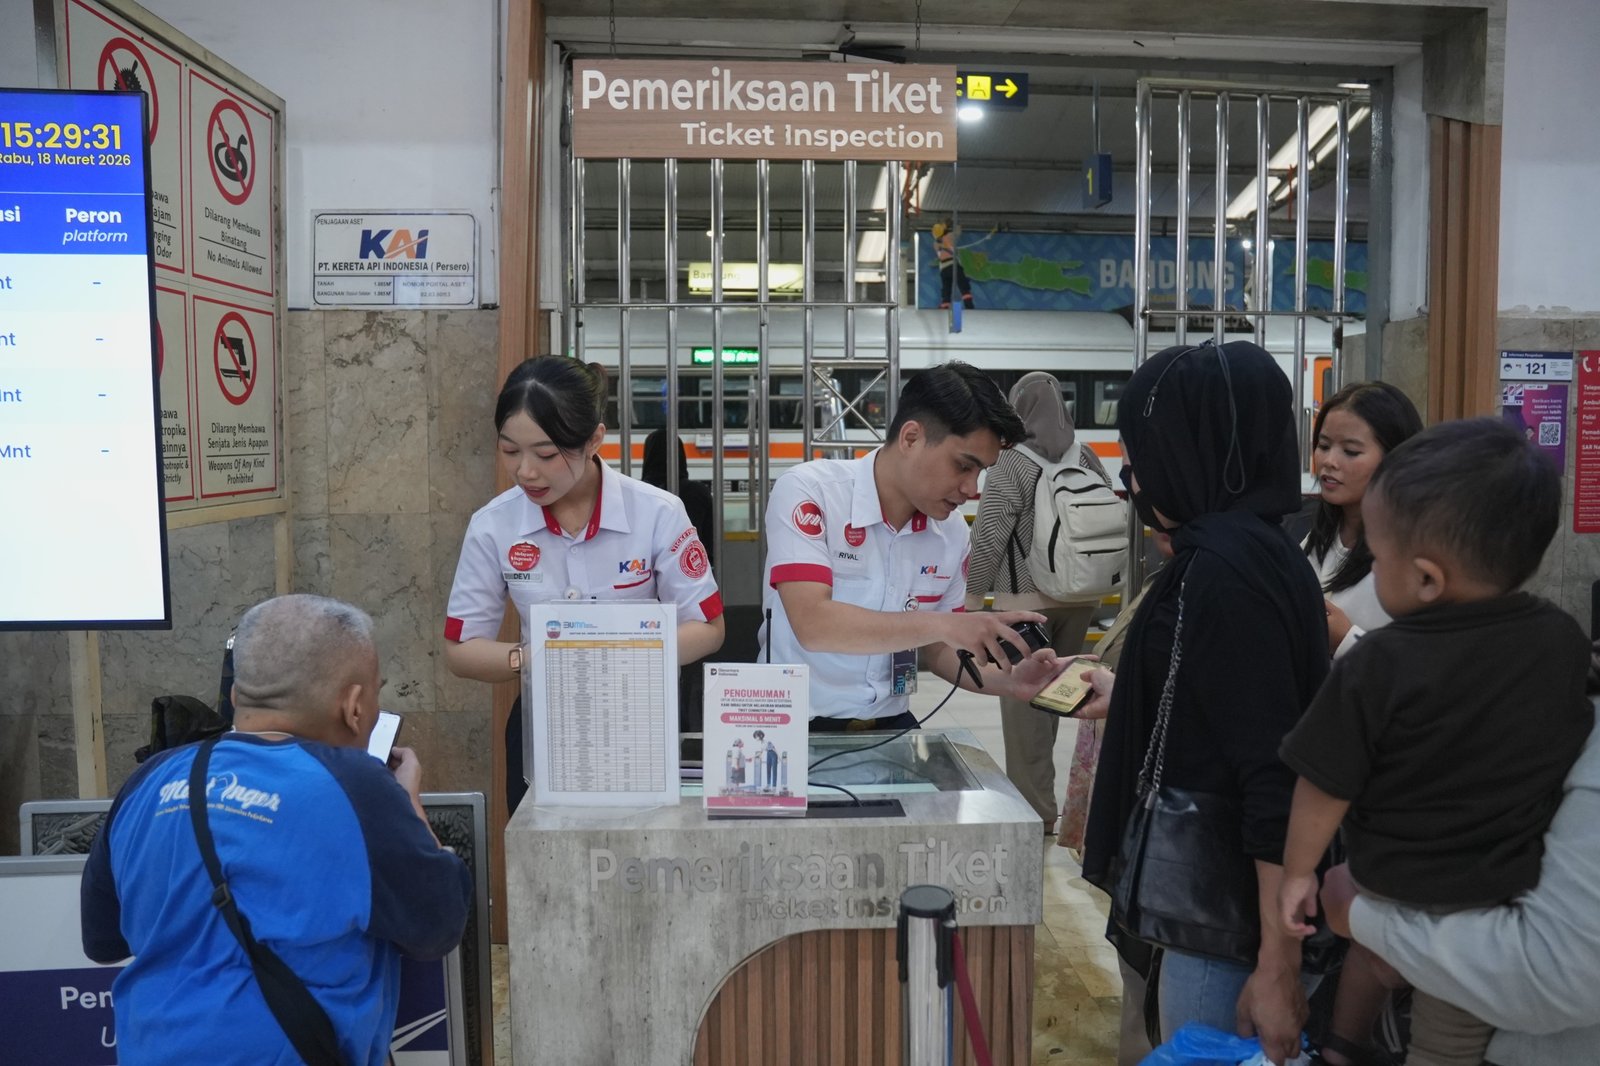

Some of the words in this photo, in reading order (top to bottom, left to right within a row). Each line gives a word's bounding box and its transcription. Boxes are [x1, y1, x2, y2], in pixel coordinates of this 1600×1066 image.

[582, 67, 835, 112] Pemeriksaan
[847, 69, 943, 114] Tiket
[1, 122, 121, 149] 15:29:31
[681, 121, 774, 146] Ticket
[785, 124, 944, 152] Inspection
[38, 153, 51, 164] 18
[55, 154, 95, 165] Maret
[98, 155, 131, 165] 2026
[1086, 168, 1092, 195] 1
[65, 208, 122, 223] Peron
[205, 207, 231, 229] Dilarang
[233, 218, 261, 238] Membawa
[62, 229, 128, 245] platform
[221, 231, 247, 252] Binatang
[359, 229, 429, 259] KAI
[156, 245, 172, 259] Odor
[207, 250, 216, 262] No
[218, 253, 240, 269] Animals
[242, 261, 262, 275] Allowed
[318, 262, 330, 271] PT.
[332, 262, 365, 271] KERETA
[367, 262, 381, 271] API
[383, 262, 428, 271] INDONESIA
[1525, 363, 1546, 374] 121
[211, 422, 236, 437] Dilarang
[238, 423, 266, 433] Membawa
[208, 437, 230, 451] Senjata
[232, 437, 247, 448] Jenis
[248, 437, 269, 450] Apapun
[208, 460, 233, 474] Weapons
[234, 459, 241, 472] Of
[242, 459, 252, 471] Any
[253, 458, 265, 468] Kind
[227, 473, 254, 484] Prohibited
[838, 552, 858, 561] RIVAL
[619, 559, 646, 573] KAI
[920, 565, 938, 575] KAI
[640, 621, 661, 629] KAI
[724, 689, 785, 699] PENGUMUMAN
[589, 841, 885, 893] Pemeriksaan
[900, 837, 1008, 887] Tiket
[748, 895, 839, 920] Ticket
